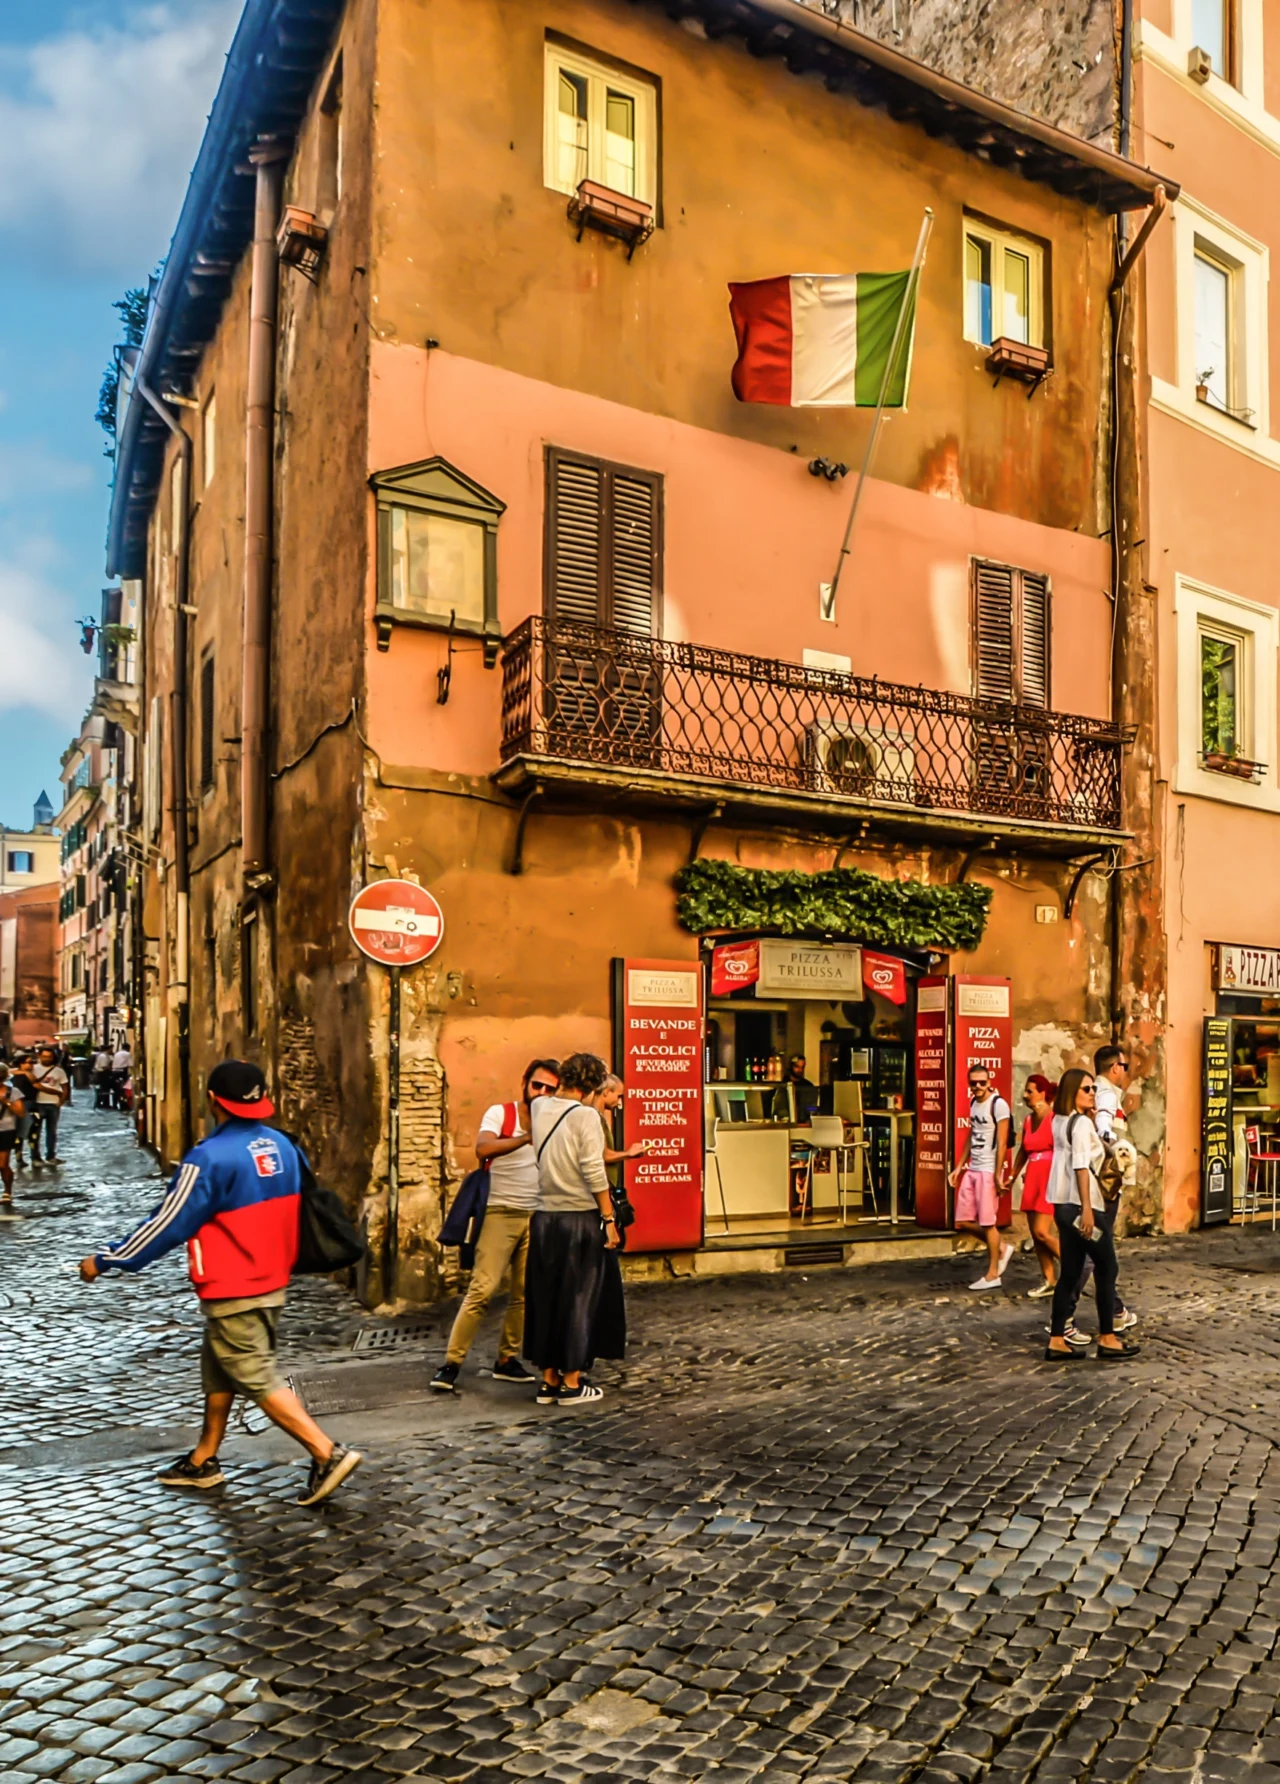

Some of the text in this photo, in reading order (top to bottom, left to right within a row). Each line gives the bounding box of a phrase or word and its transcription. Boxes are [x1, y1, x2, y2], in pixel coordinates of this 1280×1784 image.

[791, 952, 831, 964] PIZZA
[777, 965, 843, 978] TRILUSSA
[643, 986, 684, 994] TRILUSSA
[630, 1019, 697, 1030] BEVANDE
[660, 1031, 667, 1040] E
[968, 1027, 1000, 1039] PIZZA
[629, 1045, 697, 1056] ALCOLICI
[973, 1041, 995, 1049] PIZZA
[627, 1088, 698, 1099] PRODOTTI
[642, 1101, 683, 1112] TIPICI
[639, 1118, 688, 1126] PRODUCTS
[921, 1123, 942, 1133] DOLCI
[641, 1138, 685, 1149] DOLCI
[920, 1151, 943, 1162] GELATI
[638, 1163, 689, 1175] GELATI
[635, 1174, 692, 1184] ICE CREAMS
